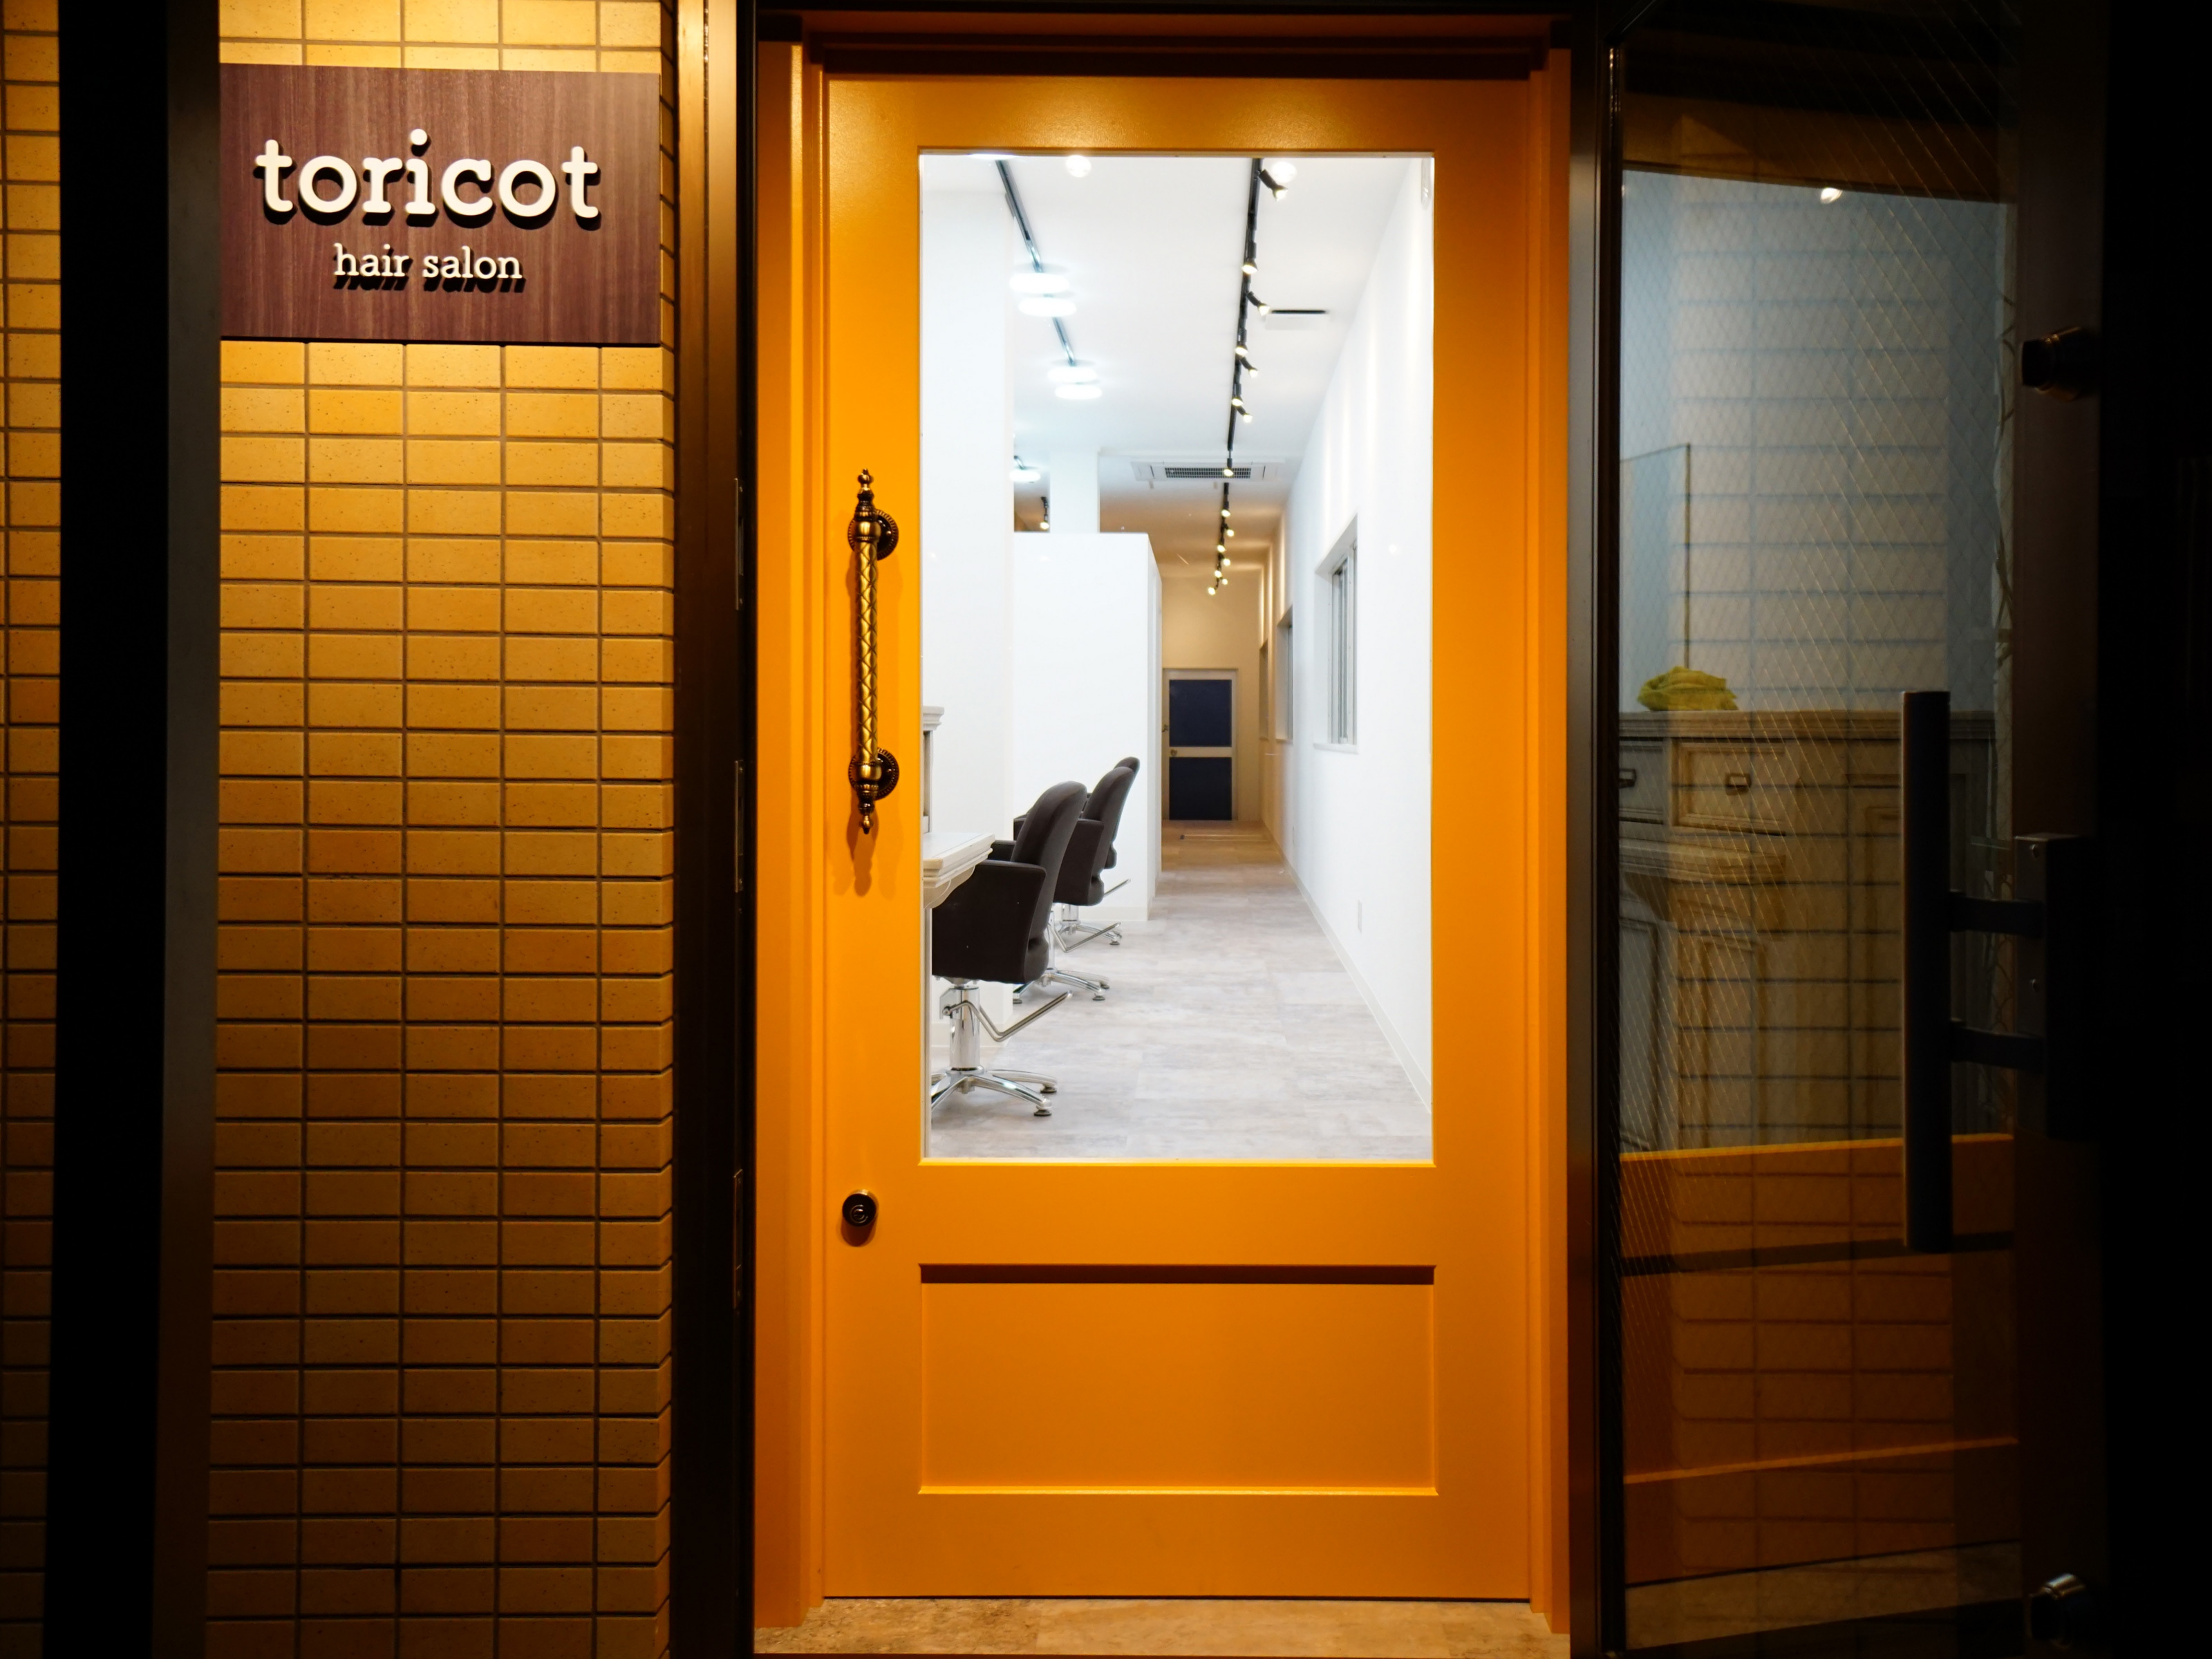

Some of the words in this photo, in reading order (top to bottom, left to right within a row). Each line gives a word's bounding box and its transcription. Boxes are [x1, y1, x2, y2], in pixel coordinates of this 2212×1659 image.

[254, 129, 599, 218] toricot
[334, 243, 409, 277] hair
[422, 245, 523, 280] salon
